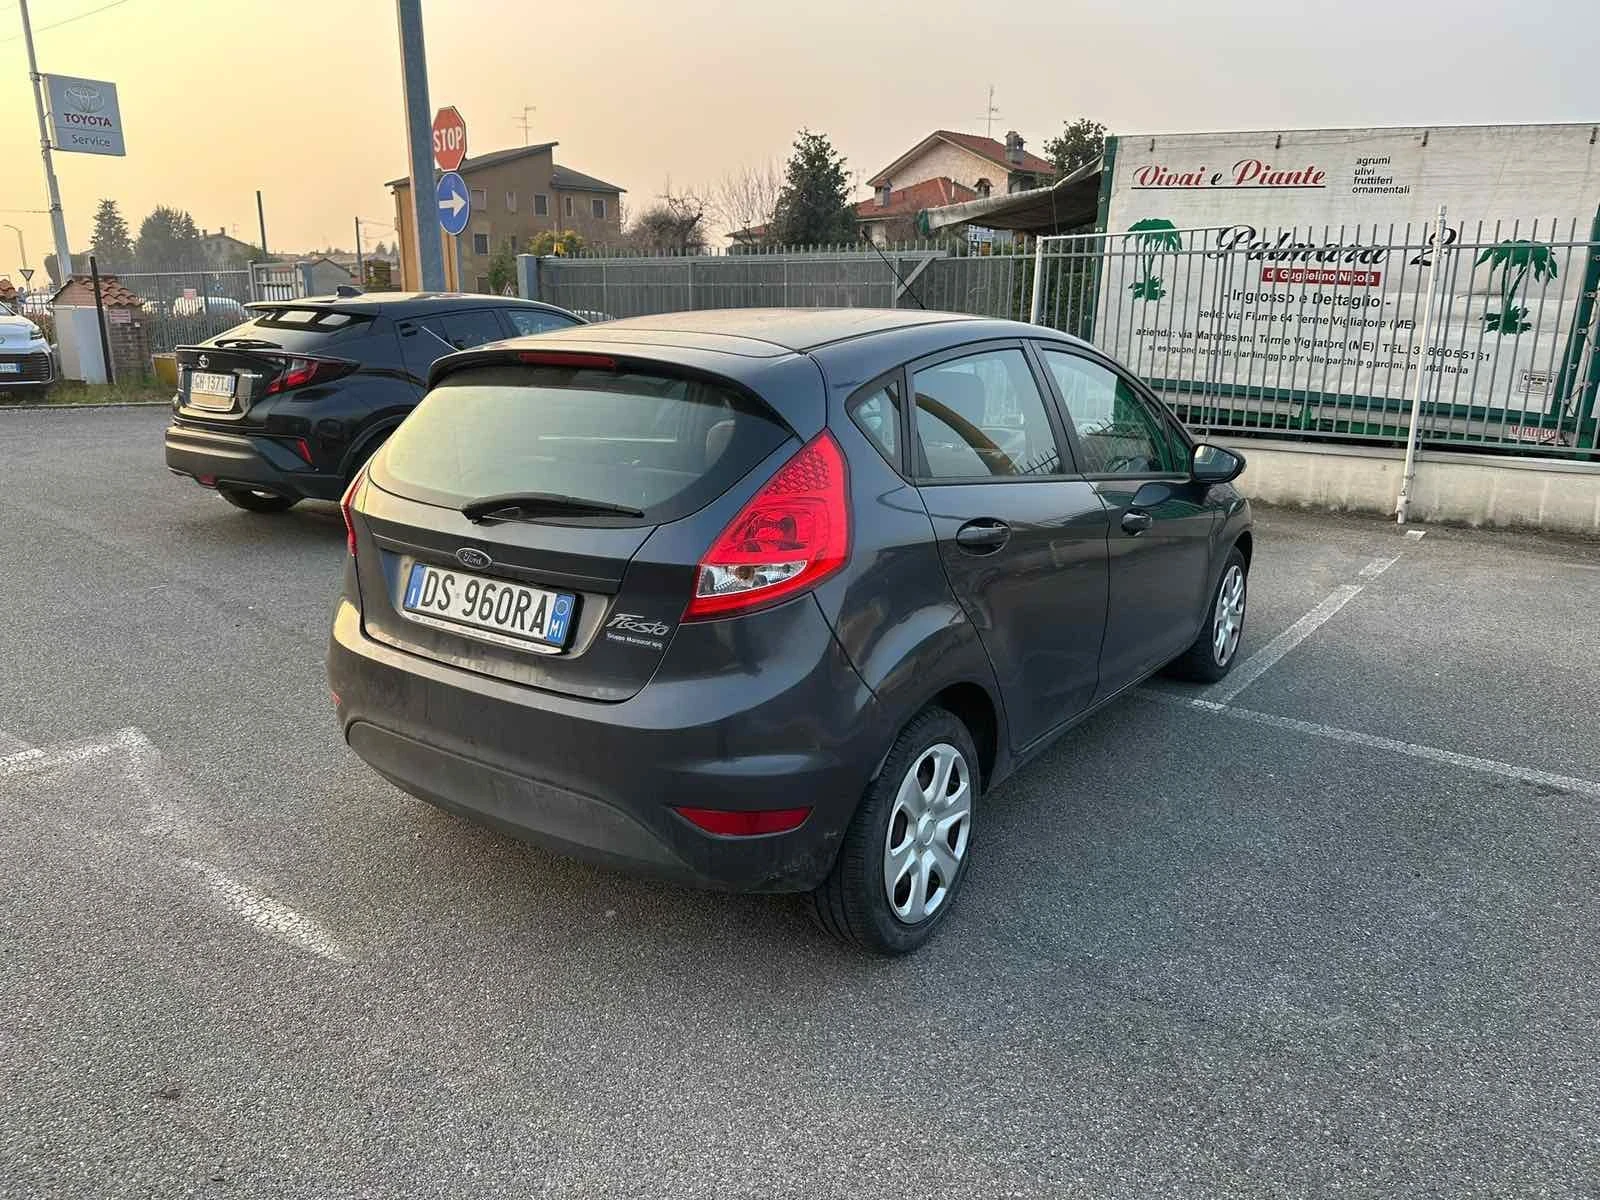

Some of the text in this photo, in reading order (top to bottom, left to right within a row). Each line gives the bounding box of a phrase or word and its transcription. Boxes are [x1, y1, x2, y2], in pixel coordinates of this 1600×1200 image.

[64, 113, 112, 127] TOYOTA
[72, 134, 110, 147] Service
[433, 126, 463, 152] STOP
[1356, 155, 1391, 166] agrumi
[1132, 159, 1326, 186] Vivai e Piante
[1354, 167, 1375, 175] ulivi
[1353, 176, 1393, 185] fruttiferi
[1352, 185, 1410, 193] ornamentali
[1444, 364, 1468, 374] Itaia
[462, 551, 483, 566] Ford
[409, 587, 416, 604] I
[421, 570, 455, 611] DS
[462, 579, 548, 635] 960RA
[550, 619, 564, 639] MI
[605, 613, 669, 636] Fiesta
